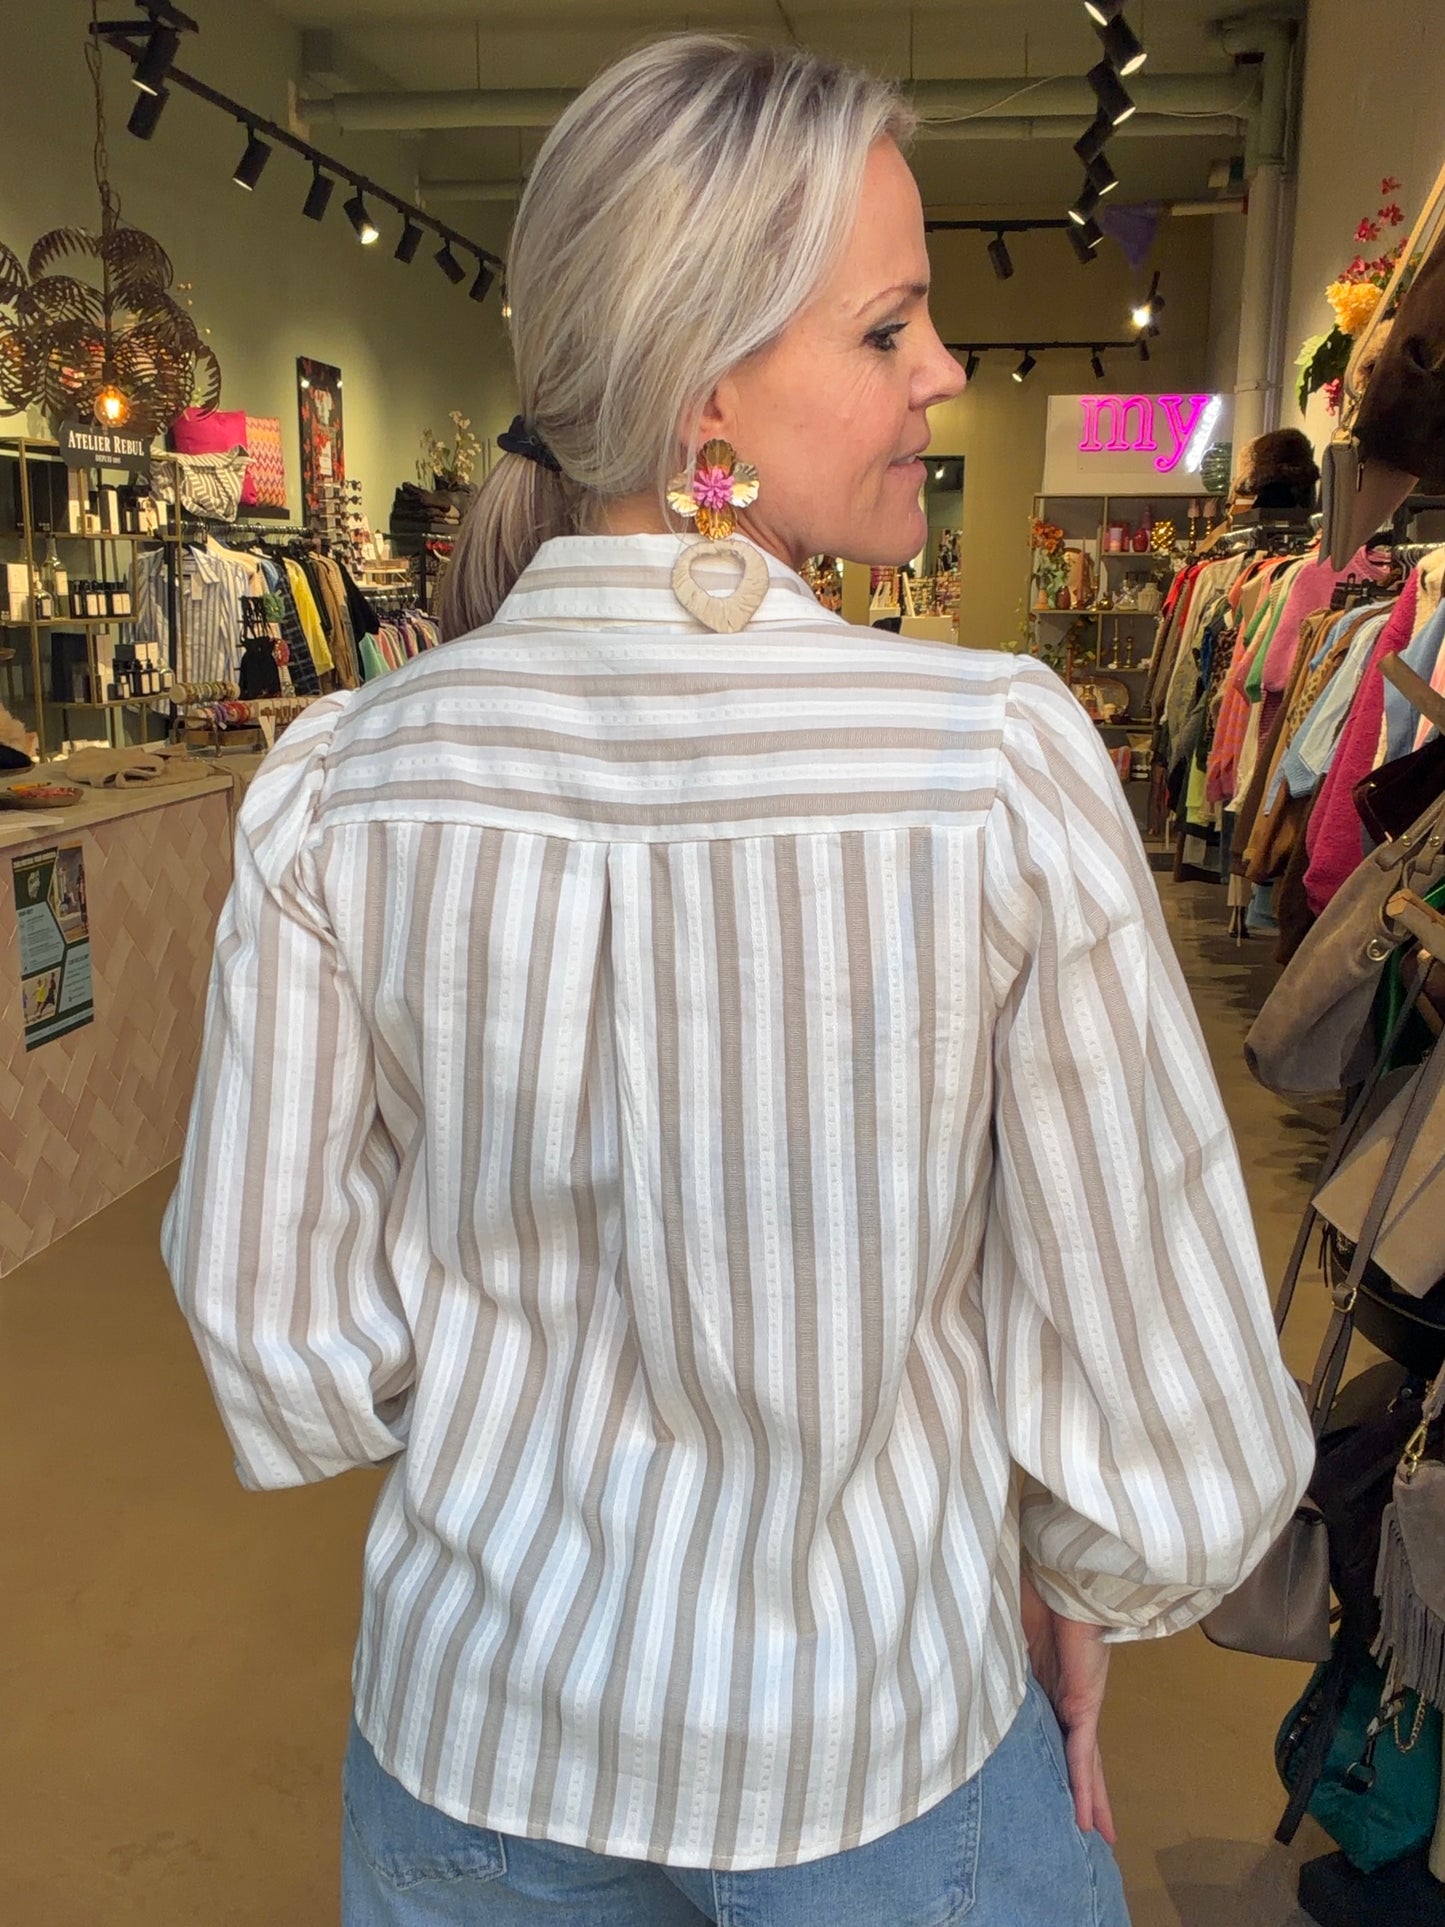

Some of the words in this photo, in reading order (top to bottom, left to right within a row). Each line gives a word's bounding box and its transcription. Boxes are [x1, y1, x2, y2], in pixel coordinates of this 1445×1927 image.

[68, 430, 111, 452] ATELIER
[113, 435, 145, 456] REBUL
[1078, 394, 1209, 473] my
